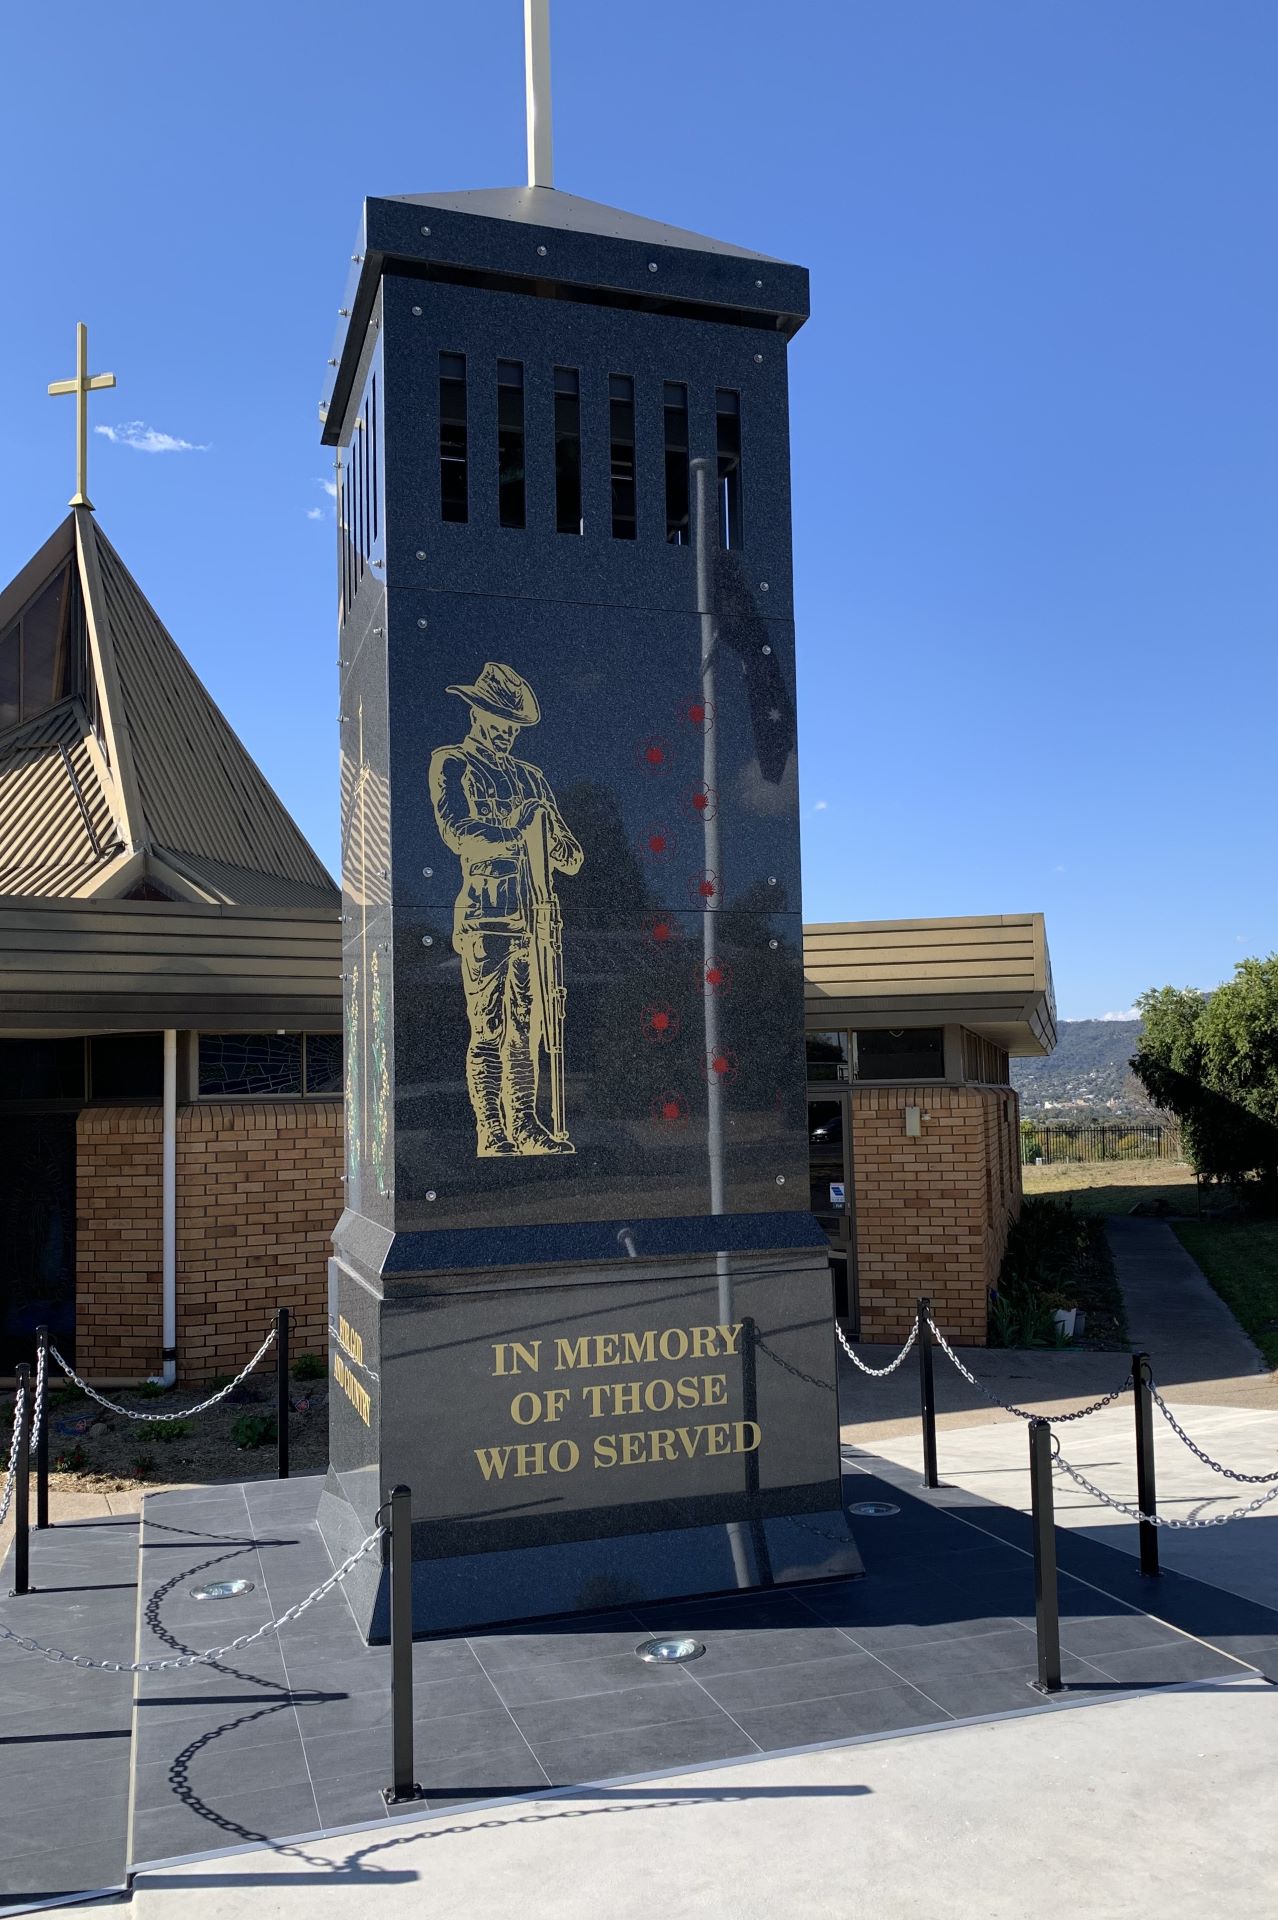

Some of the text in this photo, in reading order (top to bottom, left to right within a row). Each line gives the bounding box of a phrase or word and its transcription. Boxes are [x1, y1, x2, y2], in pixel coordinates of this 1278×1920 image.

[491, 1323, 744, 1377] IN MEMORY
[344, 1365, 371, 1428] COUNTRY
[510, 1374, 728, 1426] OF THOSE
[474, 1420, 763, 1482] WHO SERVED
